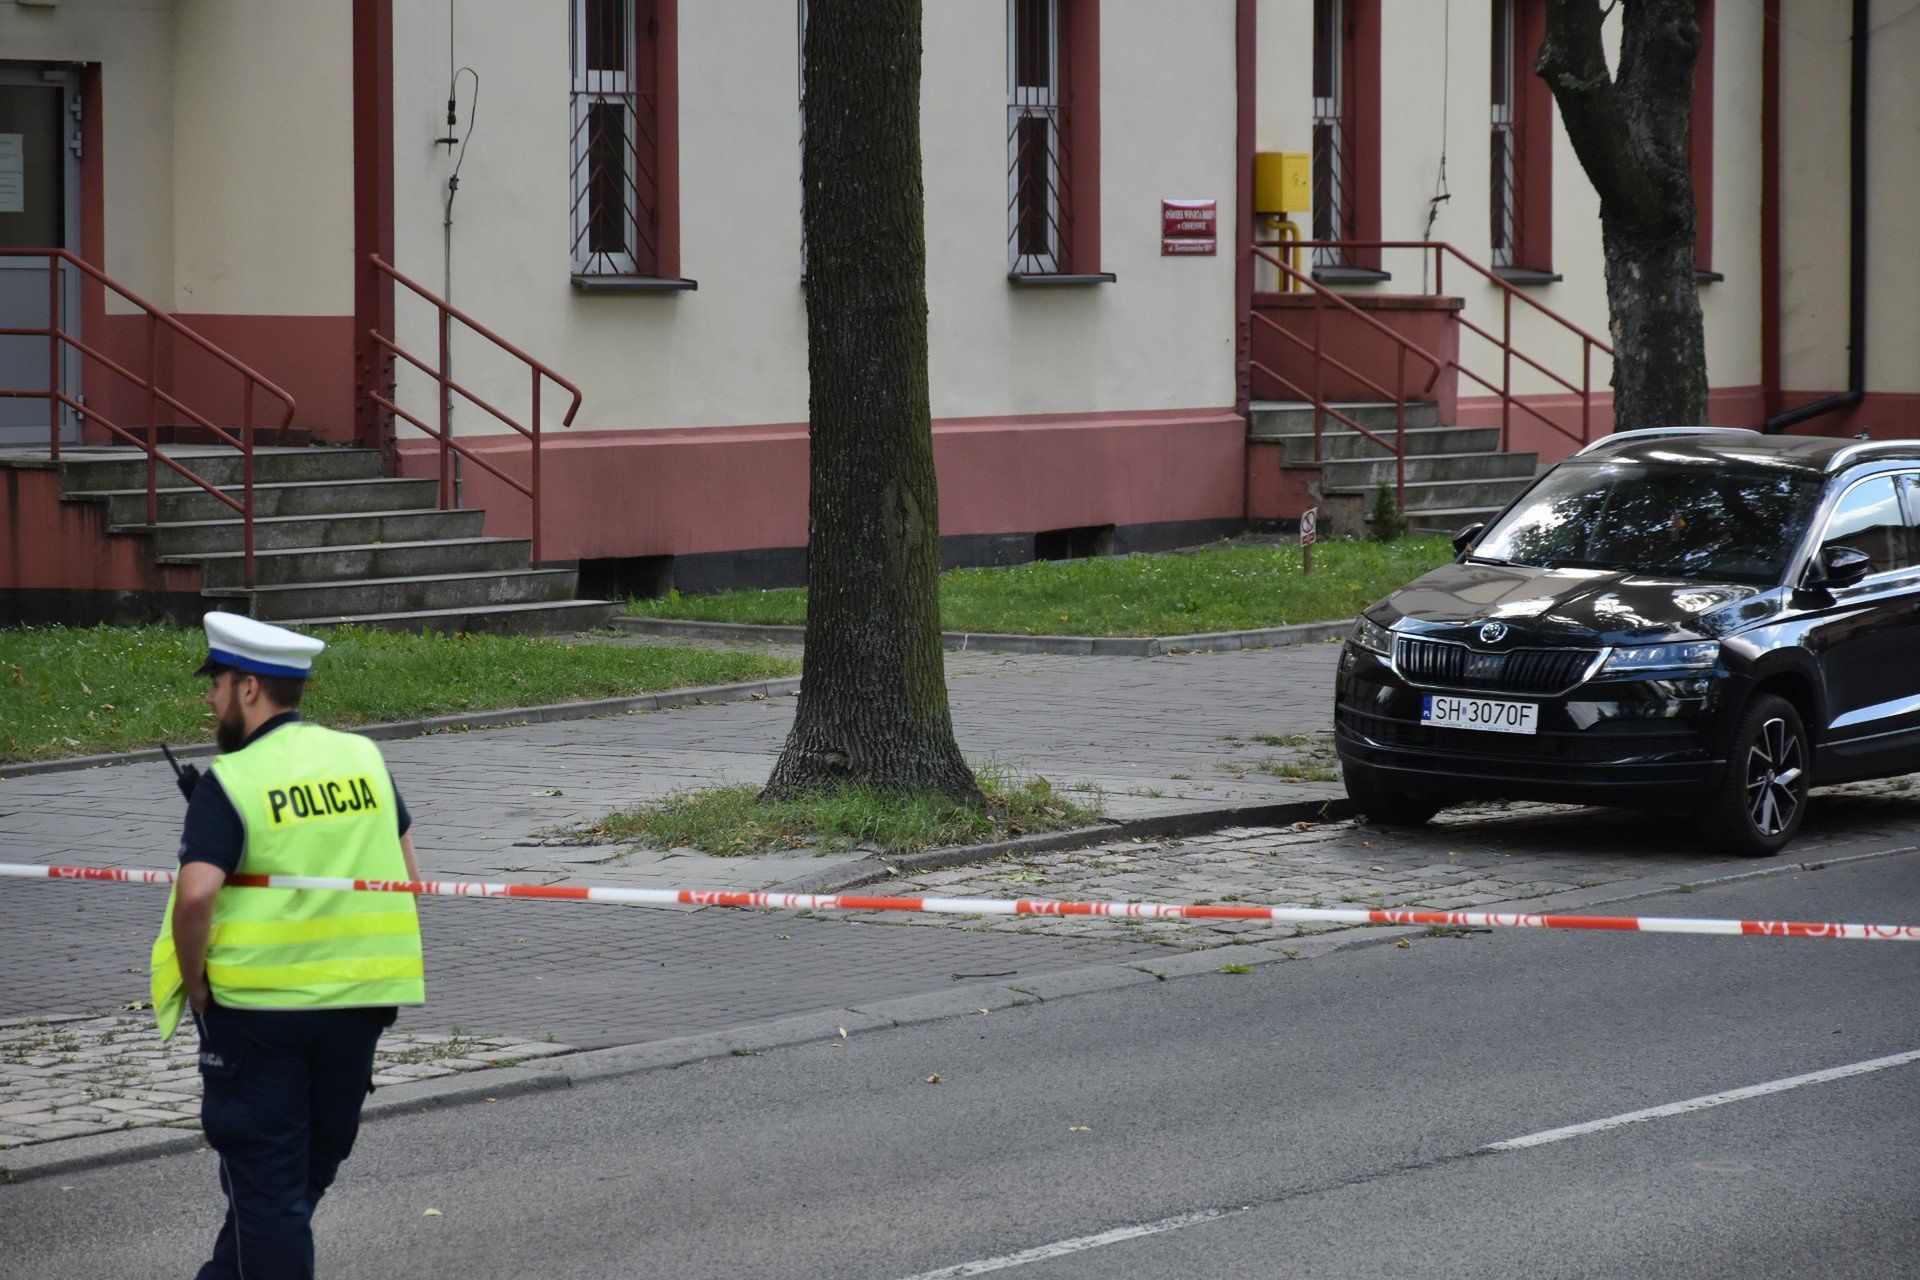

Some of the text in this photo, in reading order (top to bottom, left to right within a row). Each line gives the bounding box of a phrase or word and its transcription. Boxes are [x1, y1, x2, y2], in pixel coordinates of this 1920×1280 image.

[1436, 699, 1532, 726] SH 3070F
[267, 777, 377, 823] POLICJA
